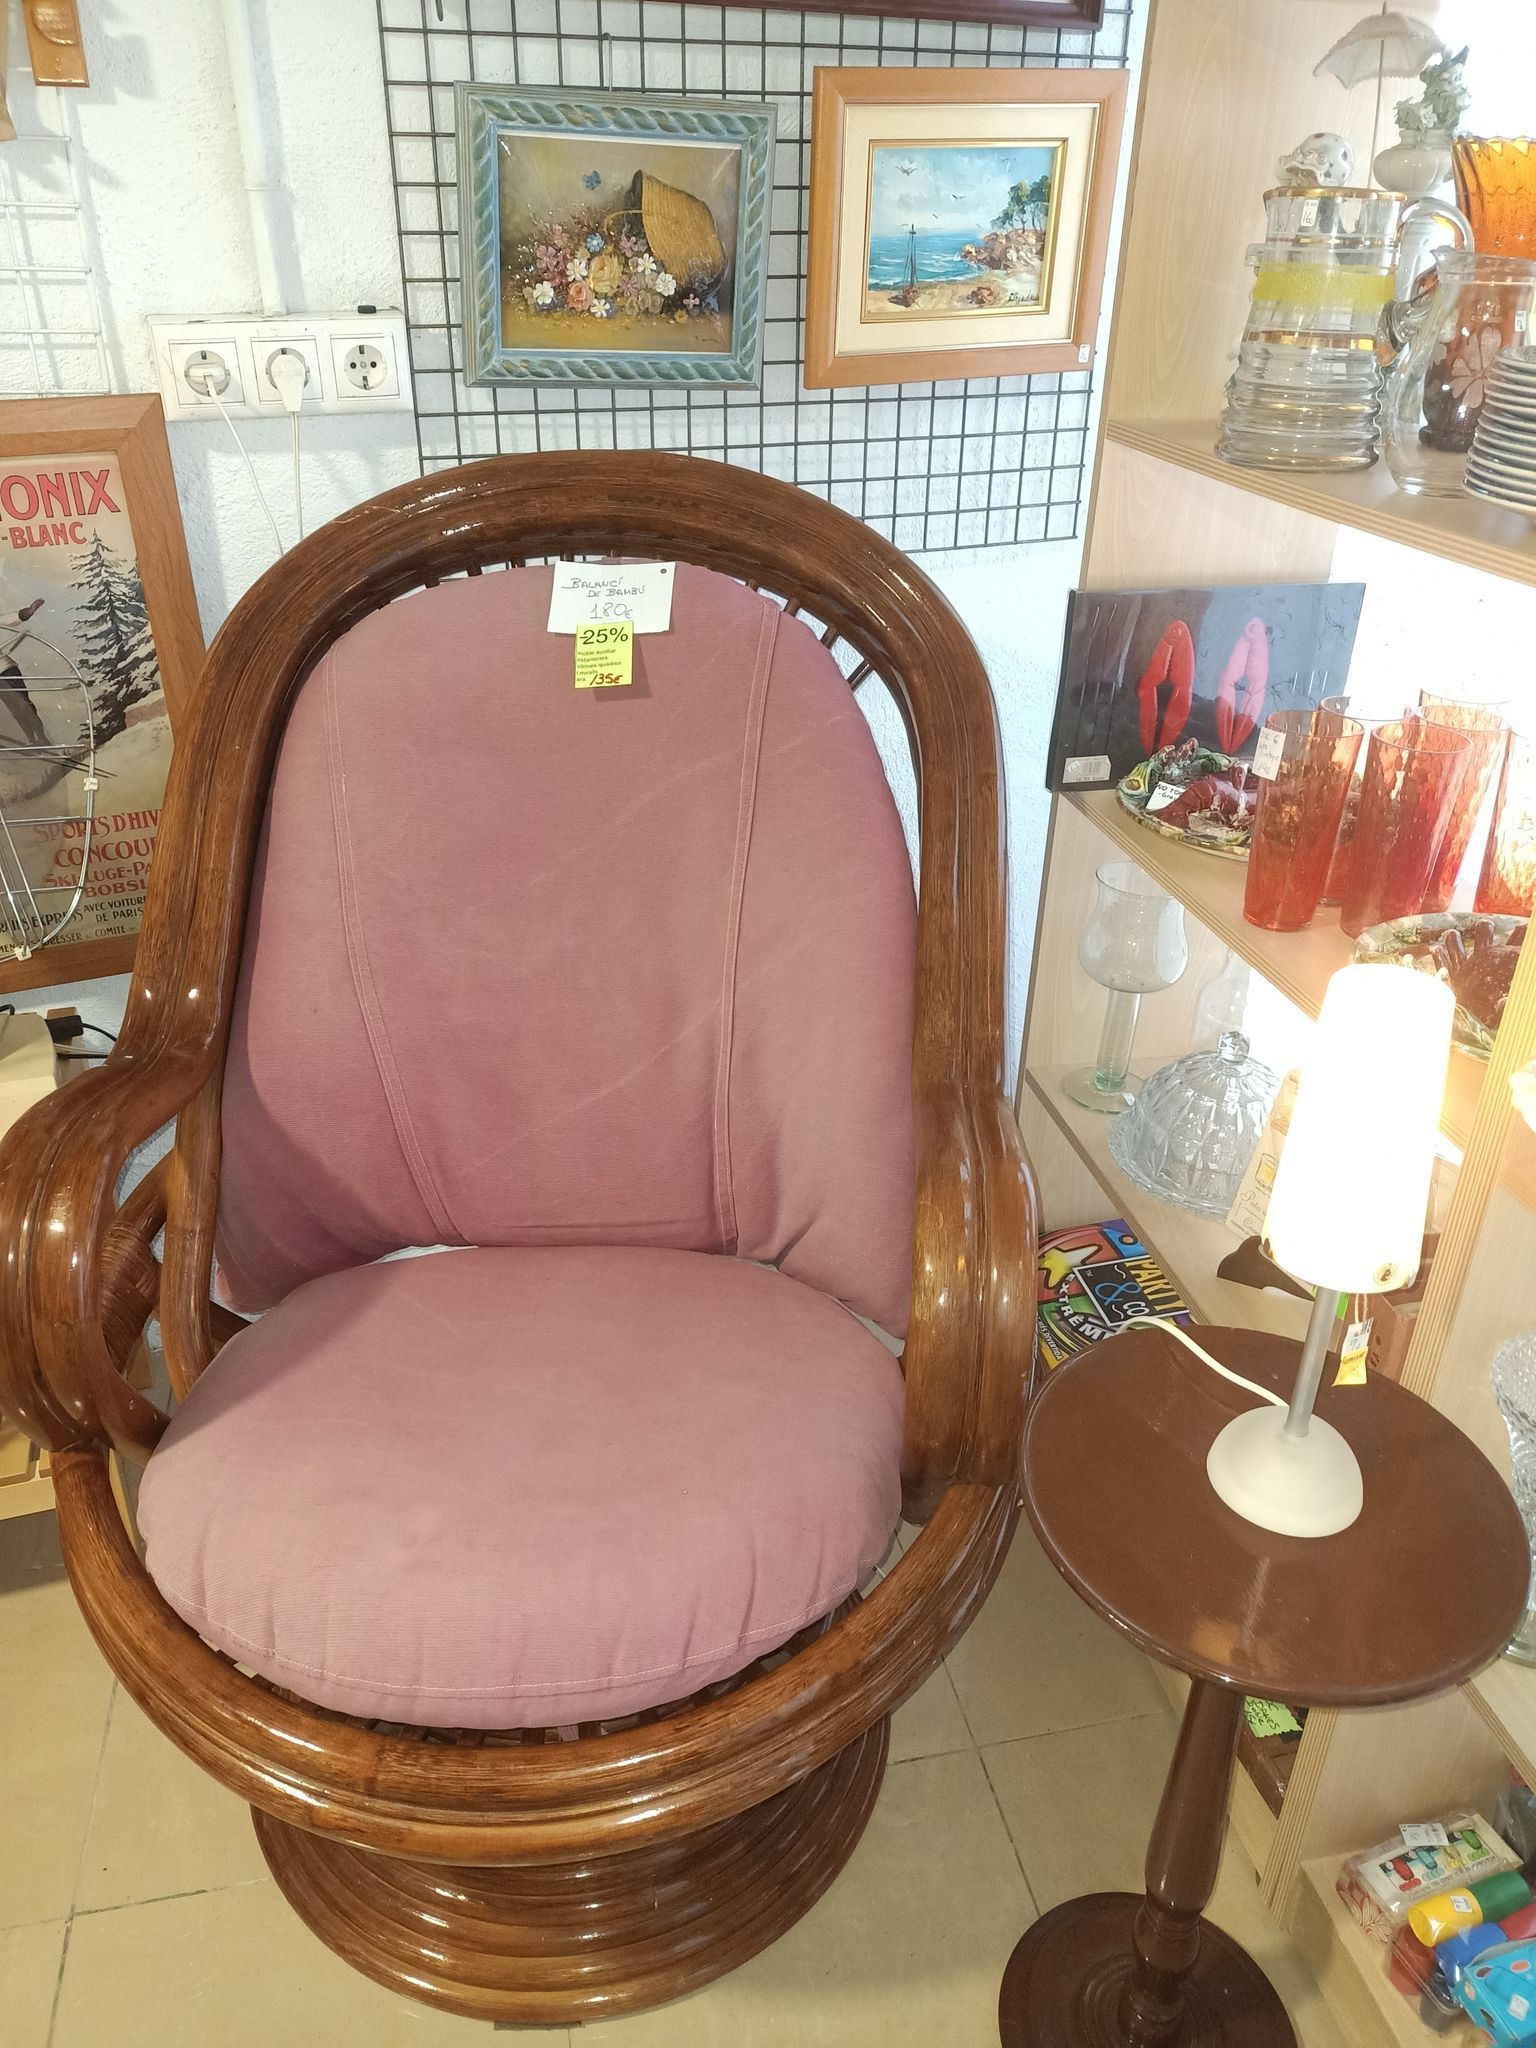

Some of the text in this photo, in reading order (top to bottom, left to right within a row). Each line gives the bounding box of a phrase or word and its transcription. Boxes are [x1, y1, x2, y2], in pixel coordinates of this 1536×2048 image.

[0, 469, 121, 521] ONIX
[586, 590, 601, 598] DE
[579, 626, 629, 645] -25%
[109, 896, 146, 909] VOITUR
[95, 913, 109, 923] DE
